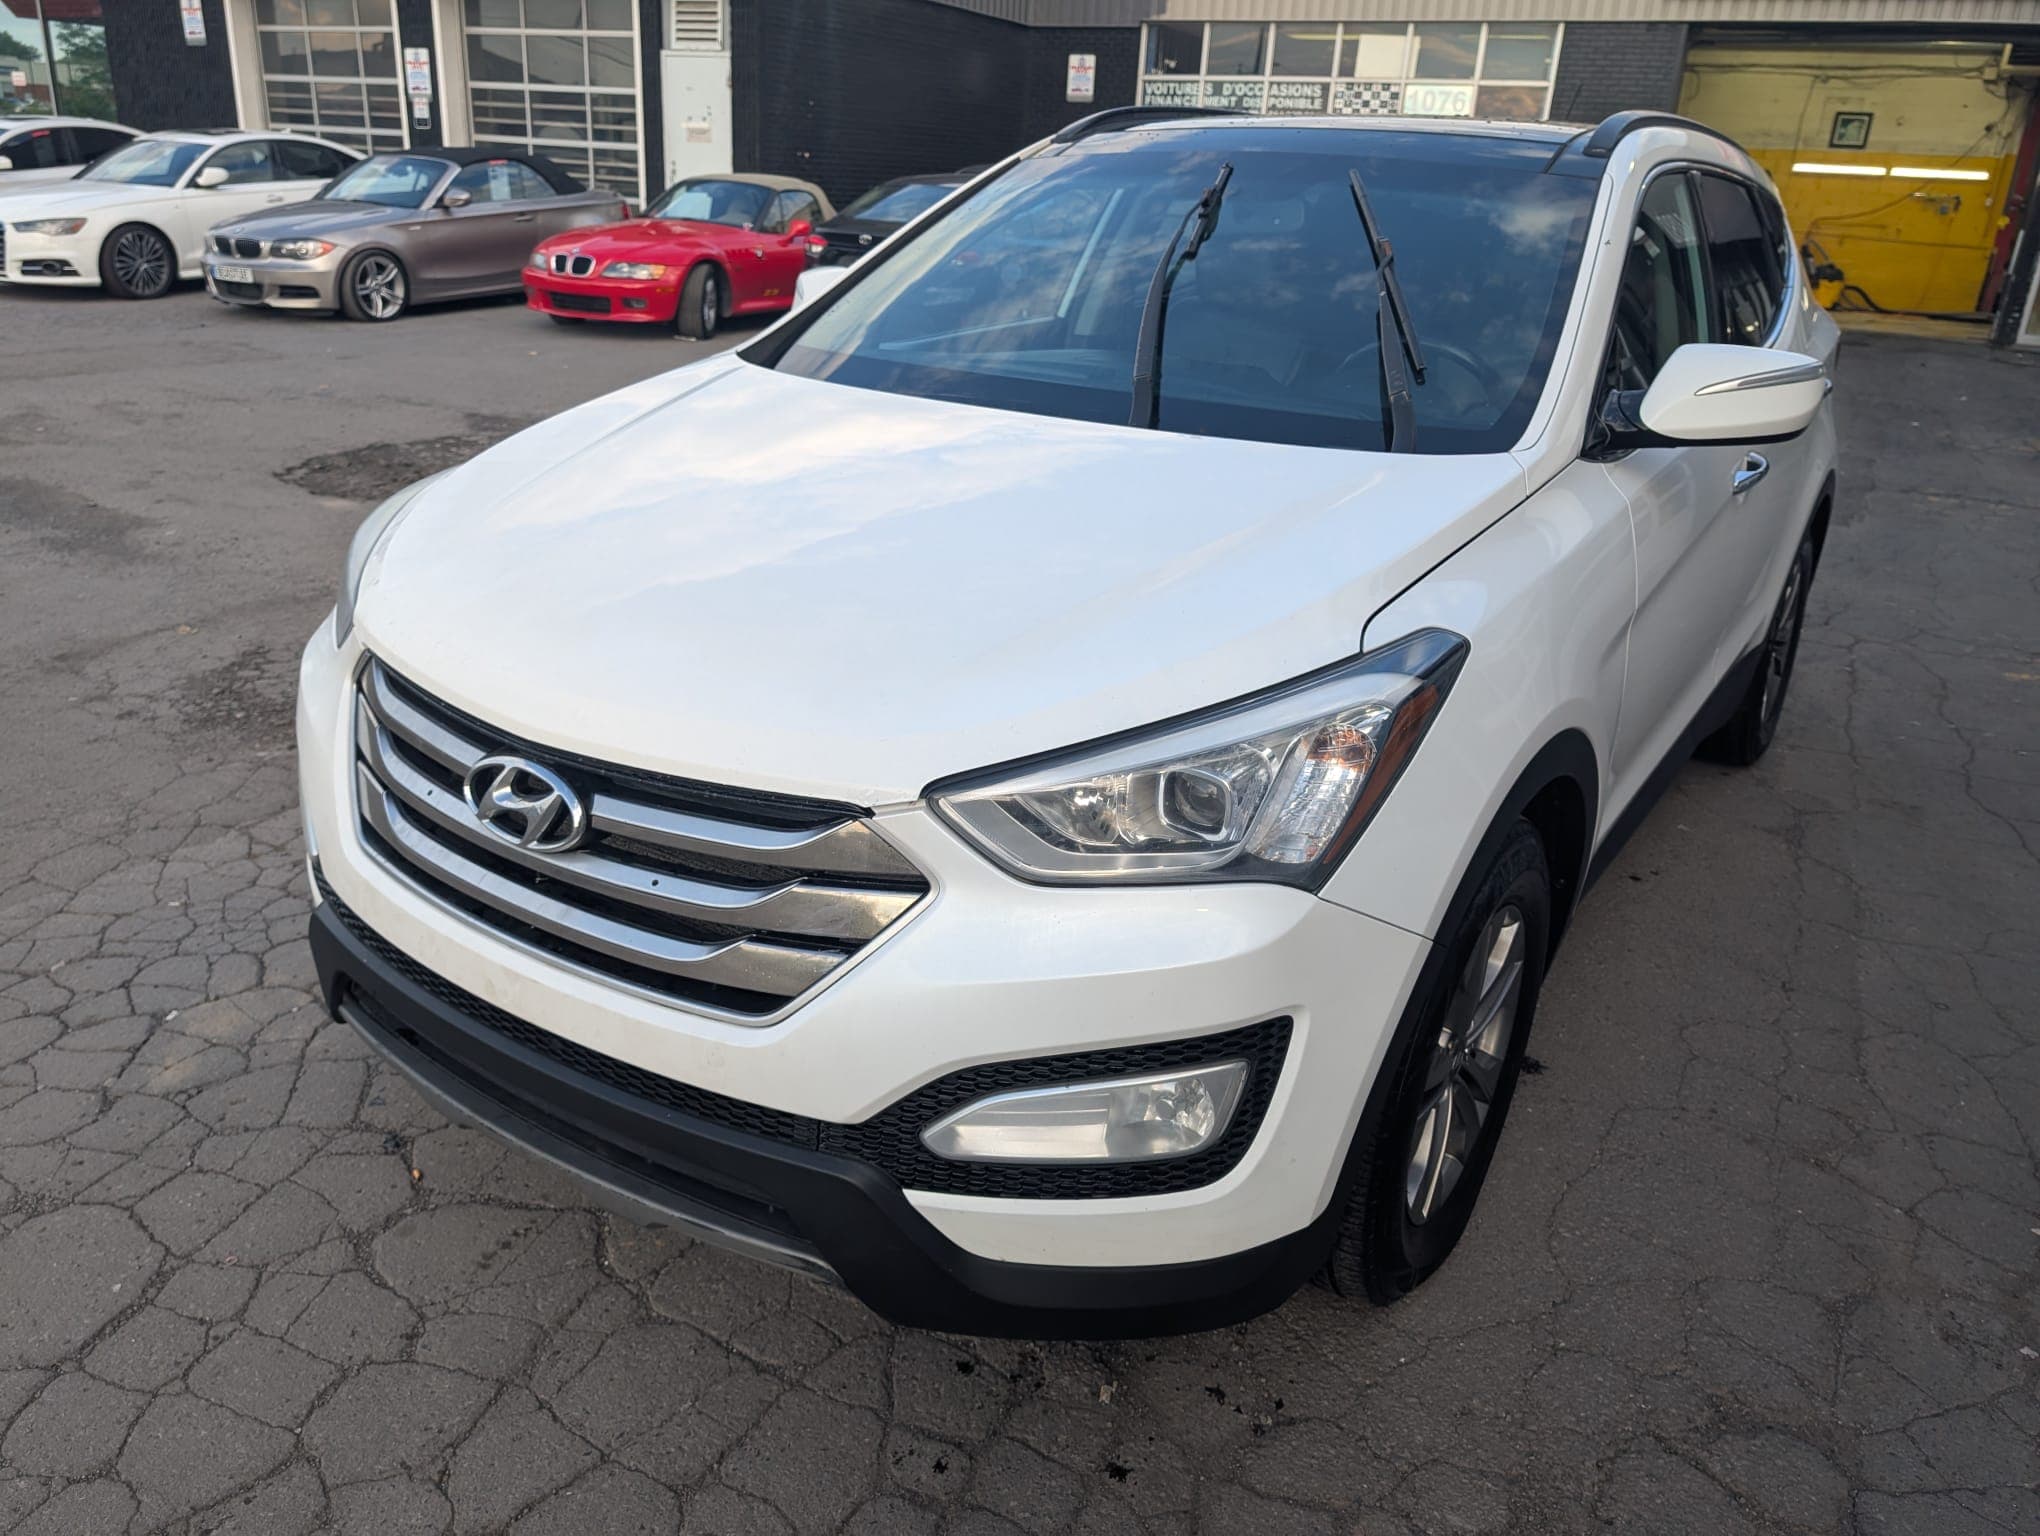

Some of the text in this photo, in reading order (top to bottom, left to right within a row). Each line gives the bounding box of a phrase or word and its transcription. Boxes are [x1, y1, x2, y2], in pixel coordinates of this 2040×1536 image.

[1145, 82, 1322, 97] VOITURES D'OCCASIONS
[1243, 96, 1323, 109] DISPONIBLE
[1407, 88, 1468, 112] 1076
